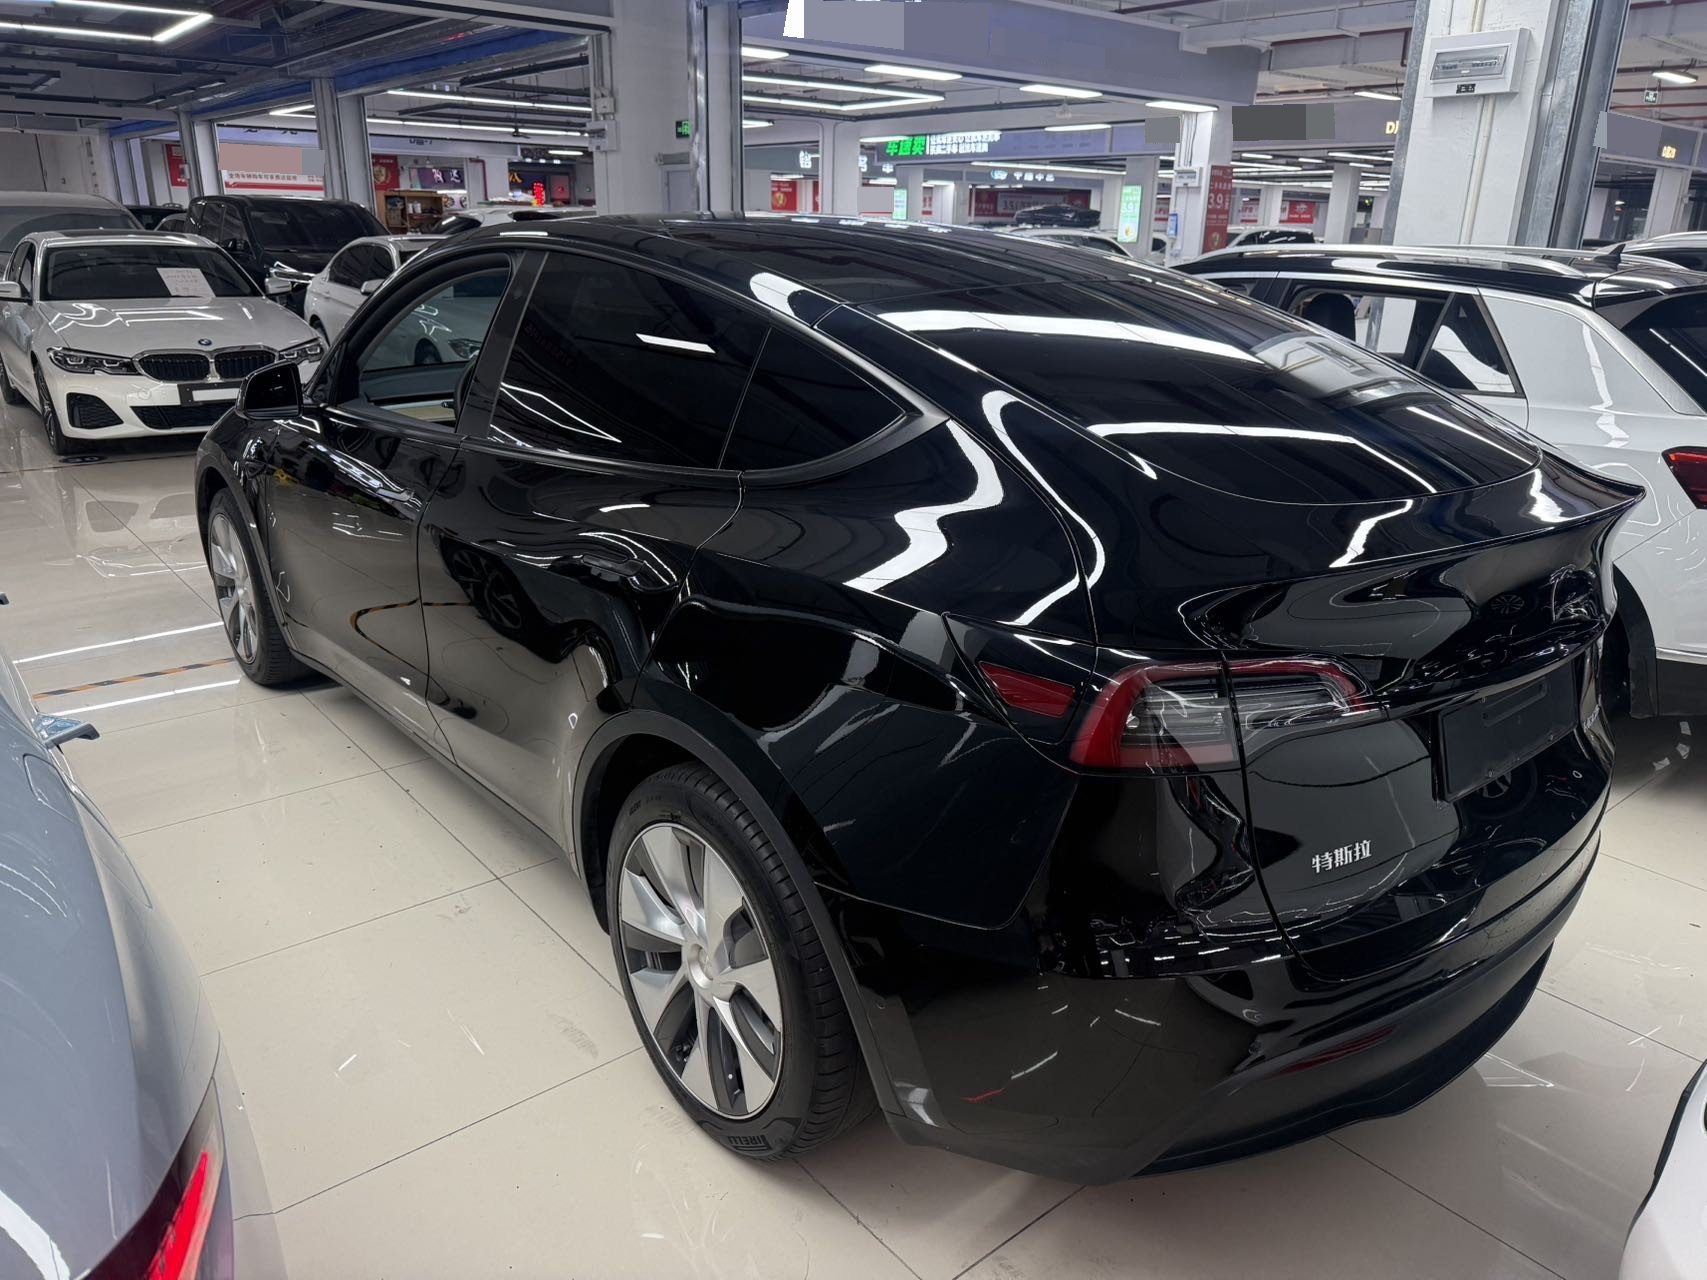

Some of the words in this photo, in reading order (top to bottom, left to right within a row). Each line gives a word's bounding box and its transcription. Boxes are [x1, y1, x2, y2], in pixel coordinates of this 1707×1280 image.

[1311, 840, 1372, 874] 特斯拉
[727, 1134, 772, 1151] PIRELLI
